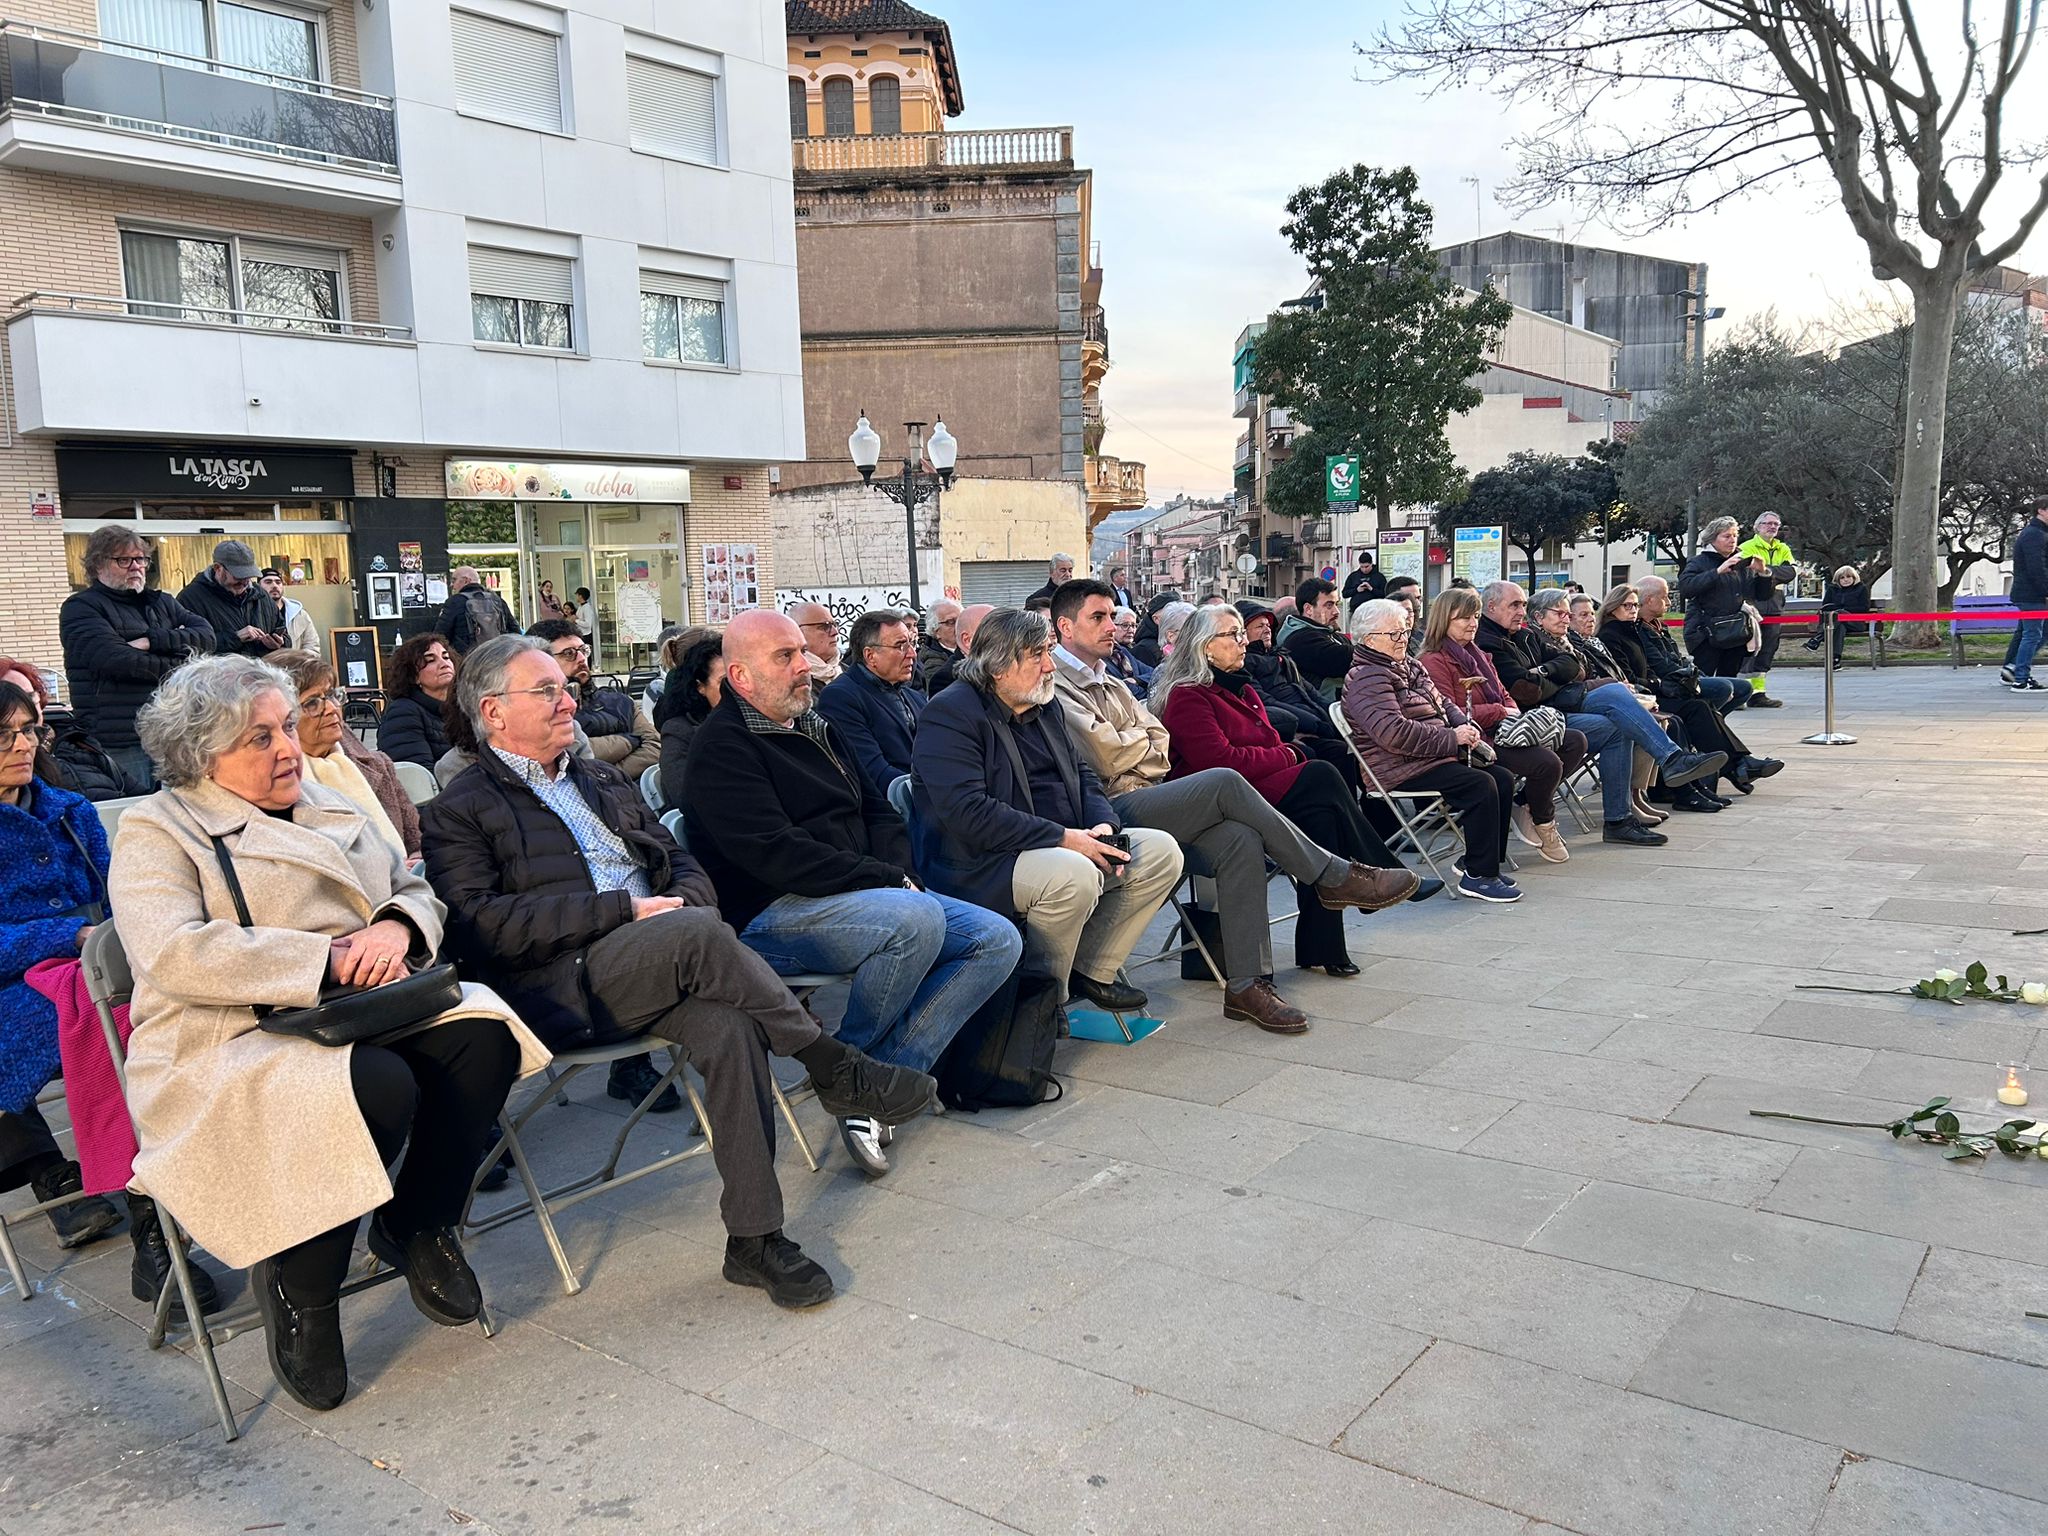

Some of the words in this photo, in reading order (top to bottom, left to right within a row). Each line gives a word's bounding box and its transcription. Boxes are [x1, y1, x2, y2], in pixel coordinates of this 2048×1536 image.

[169, 457, 199, 475] LA
[201, 458, 268, 477] TASCA
[584, 471, 635, 498] aloha
